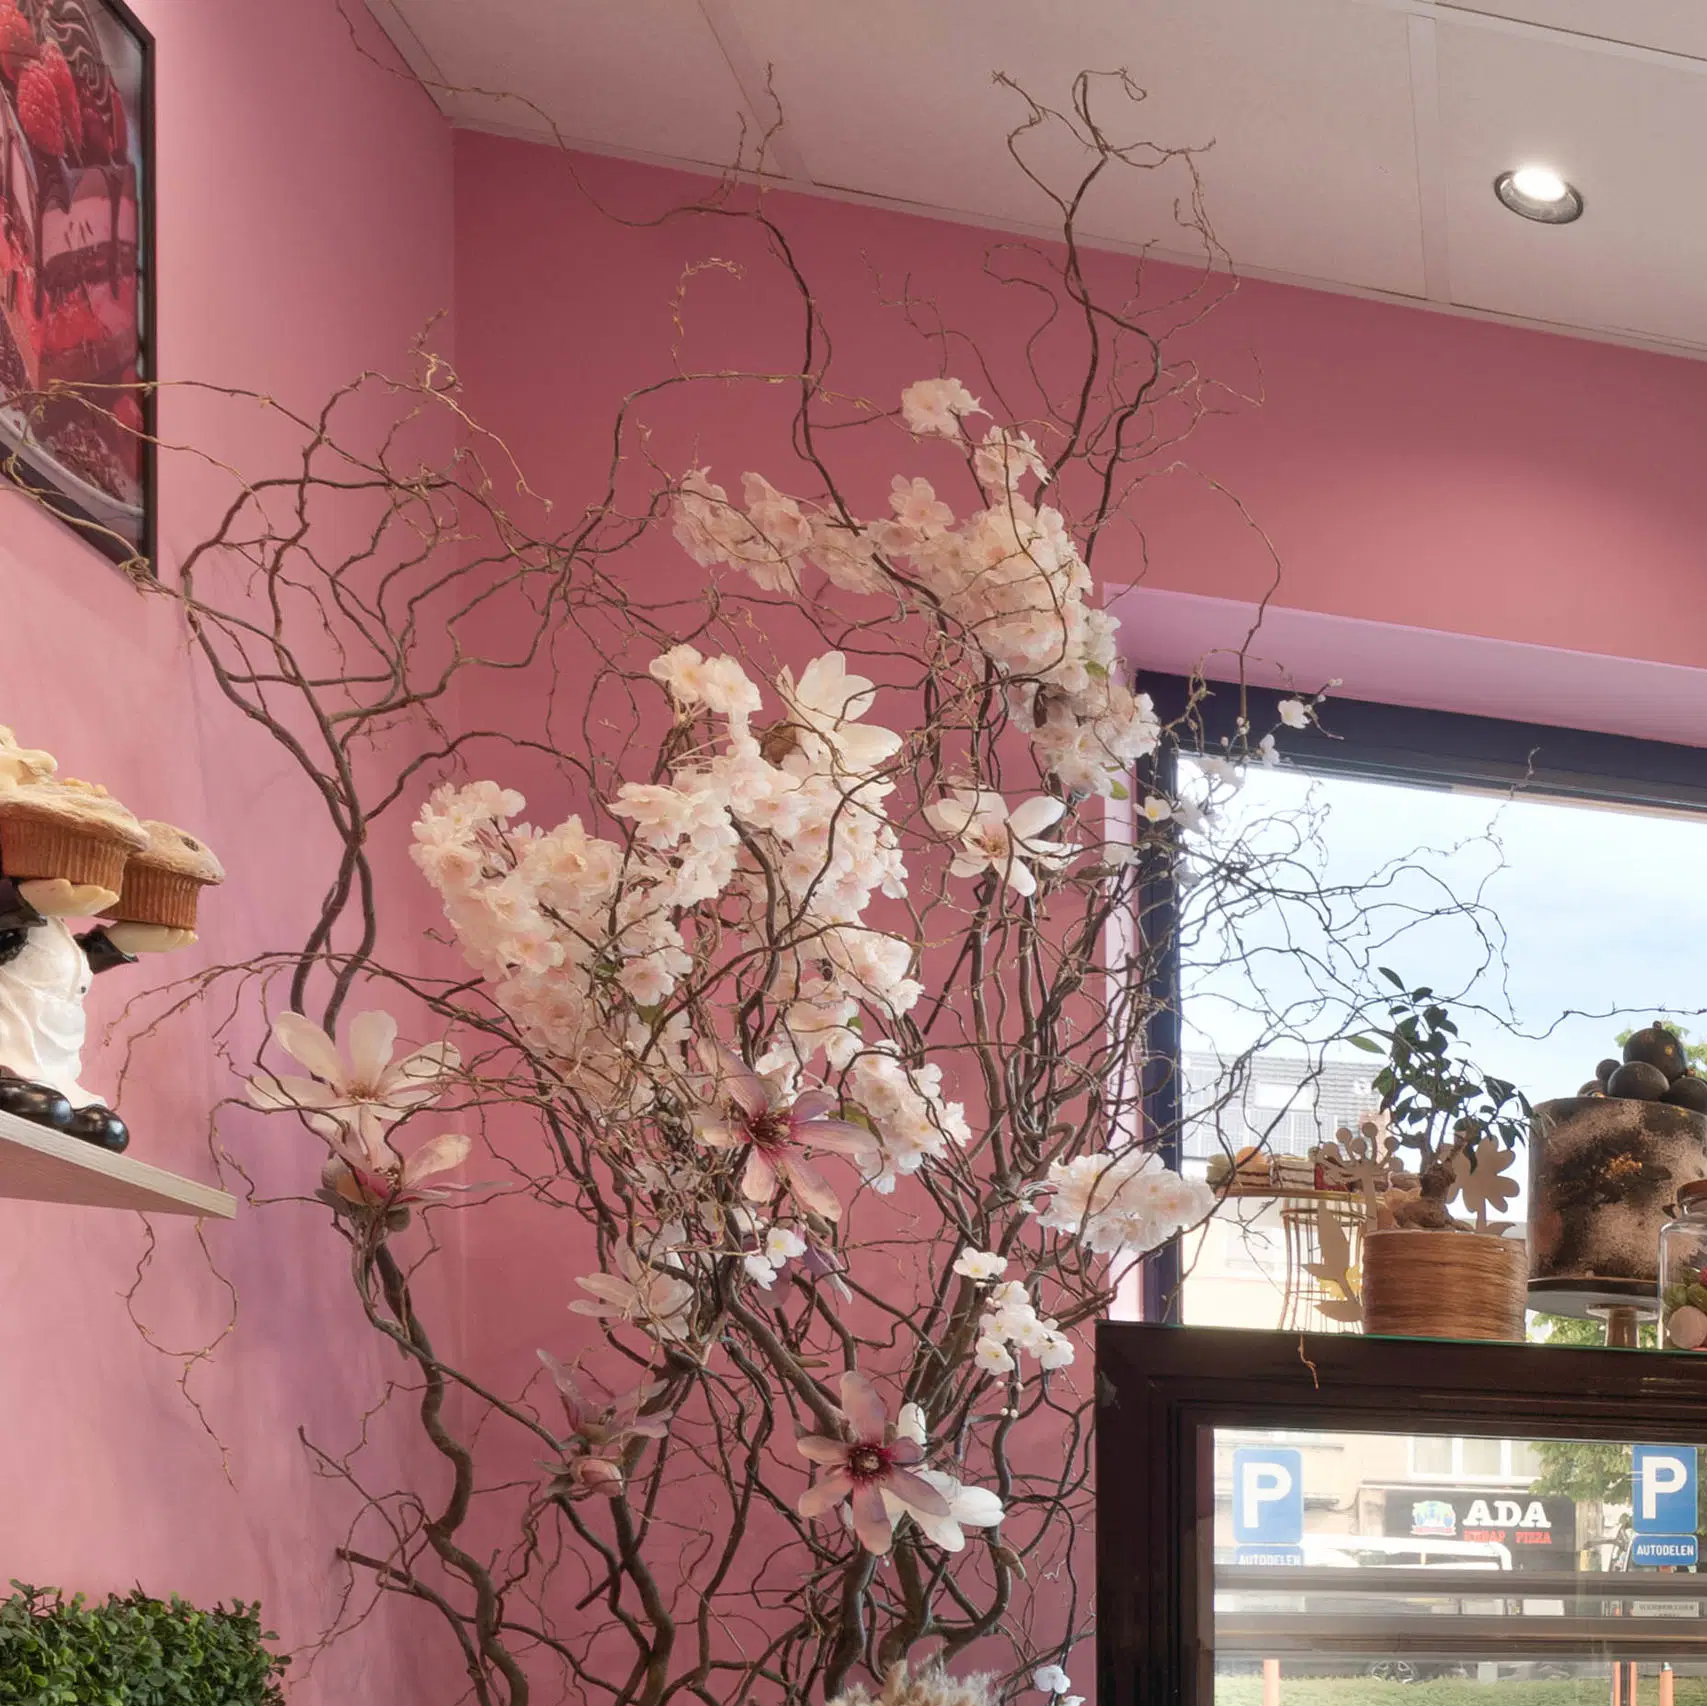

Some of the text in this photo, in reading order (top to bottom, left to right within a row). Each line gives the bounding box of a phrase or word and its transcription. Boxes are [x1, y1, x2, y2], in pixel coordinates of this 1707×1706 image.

[1243, 1462, 1293, 1528] P
[1642, 1456, 1687, 1519] P
[1462, 1499, 1552, 1528] ADA
[1636, 1544, 1694, 1557] AUTODELEN
